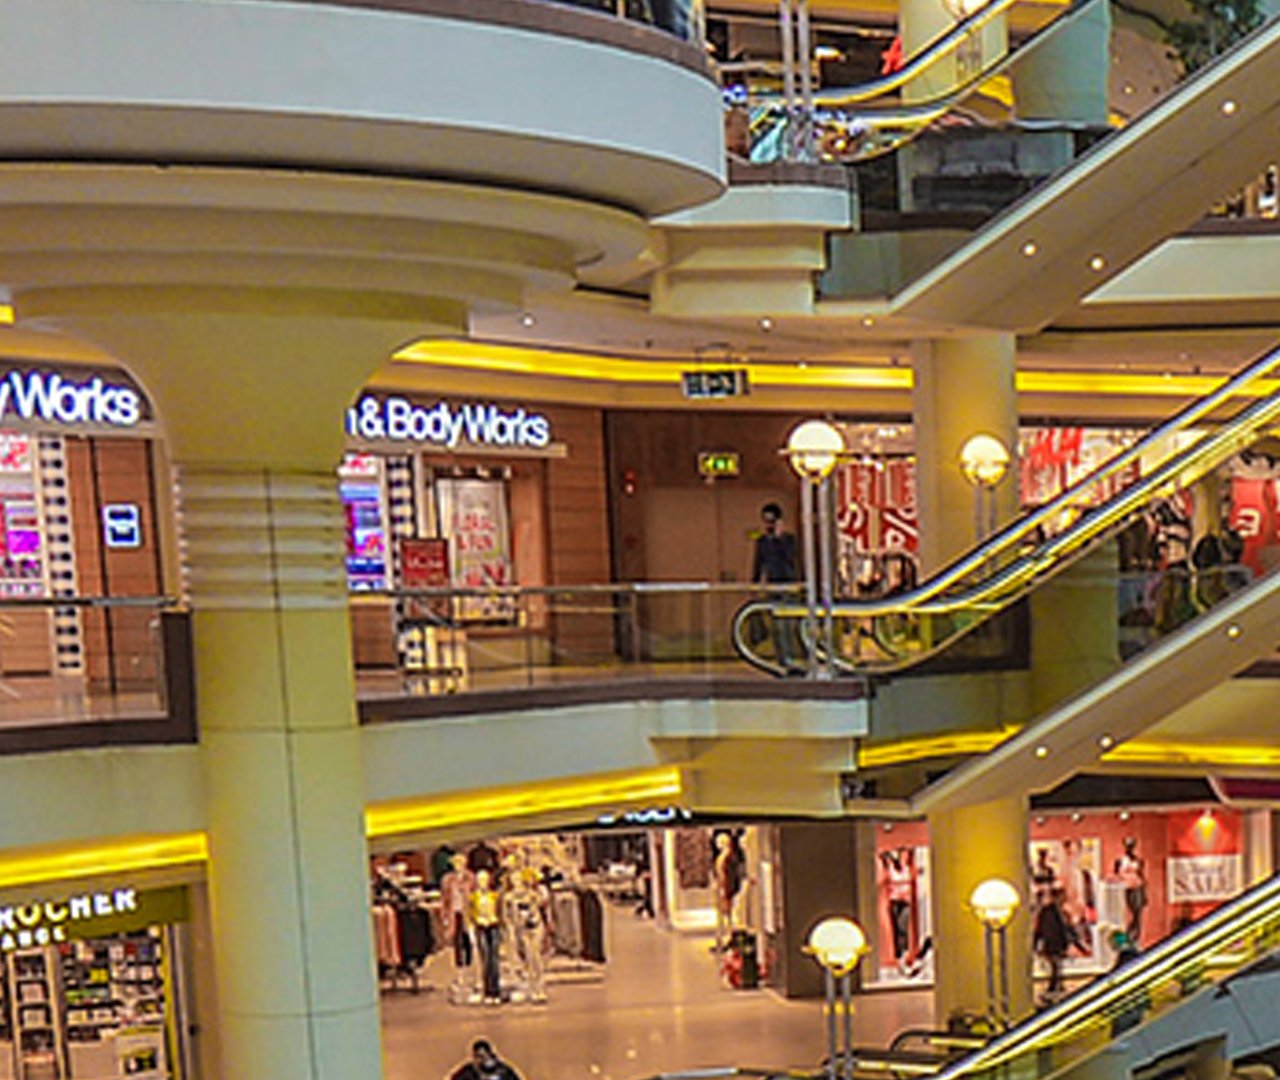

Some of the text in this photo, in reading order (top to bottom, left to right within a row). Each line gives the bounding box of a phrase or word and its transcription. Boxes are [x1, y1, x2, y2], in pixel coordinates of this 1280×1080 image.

[10, 371, 140, 425] Works
[358, 396, 387, 438] &
[386, 398, 464, 449] Body
[462, 403, 550, 448] Works
